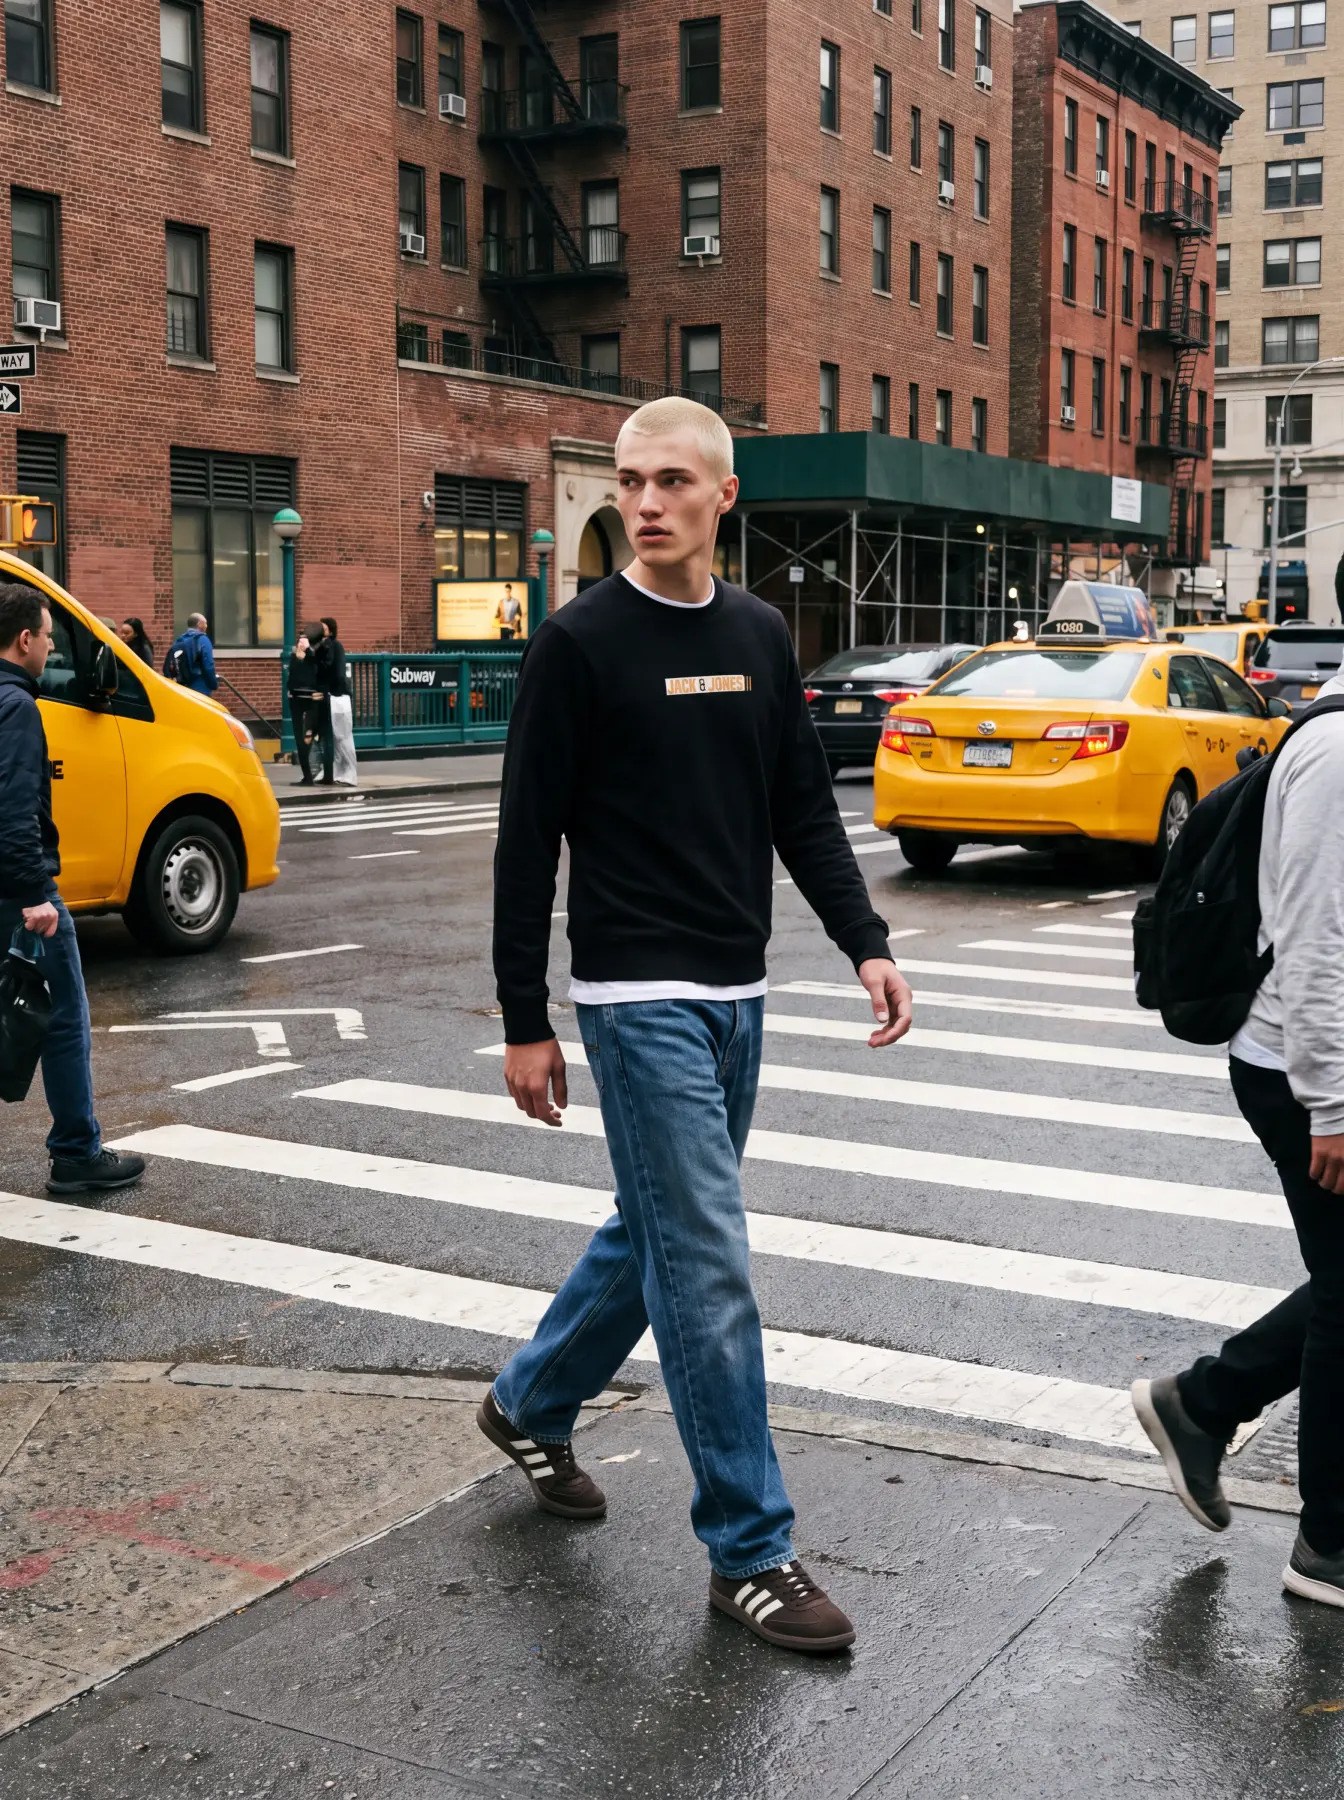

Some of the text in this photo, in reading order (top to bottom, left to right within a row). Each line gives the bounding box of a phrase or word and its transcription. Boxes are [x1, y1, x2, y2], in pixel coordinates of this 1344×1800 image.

[1, 355, 24, 368] WAY
[0, 392, 10, 403] AY
[1056, 622, 1083, 633] 1080
[390, 667, 436, 686] Subway
[667, 679, 697, 694] JACK
[708, 676, 743, 691] JONES
